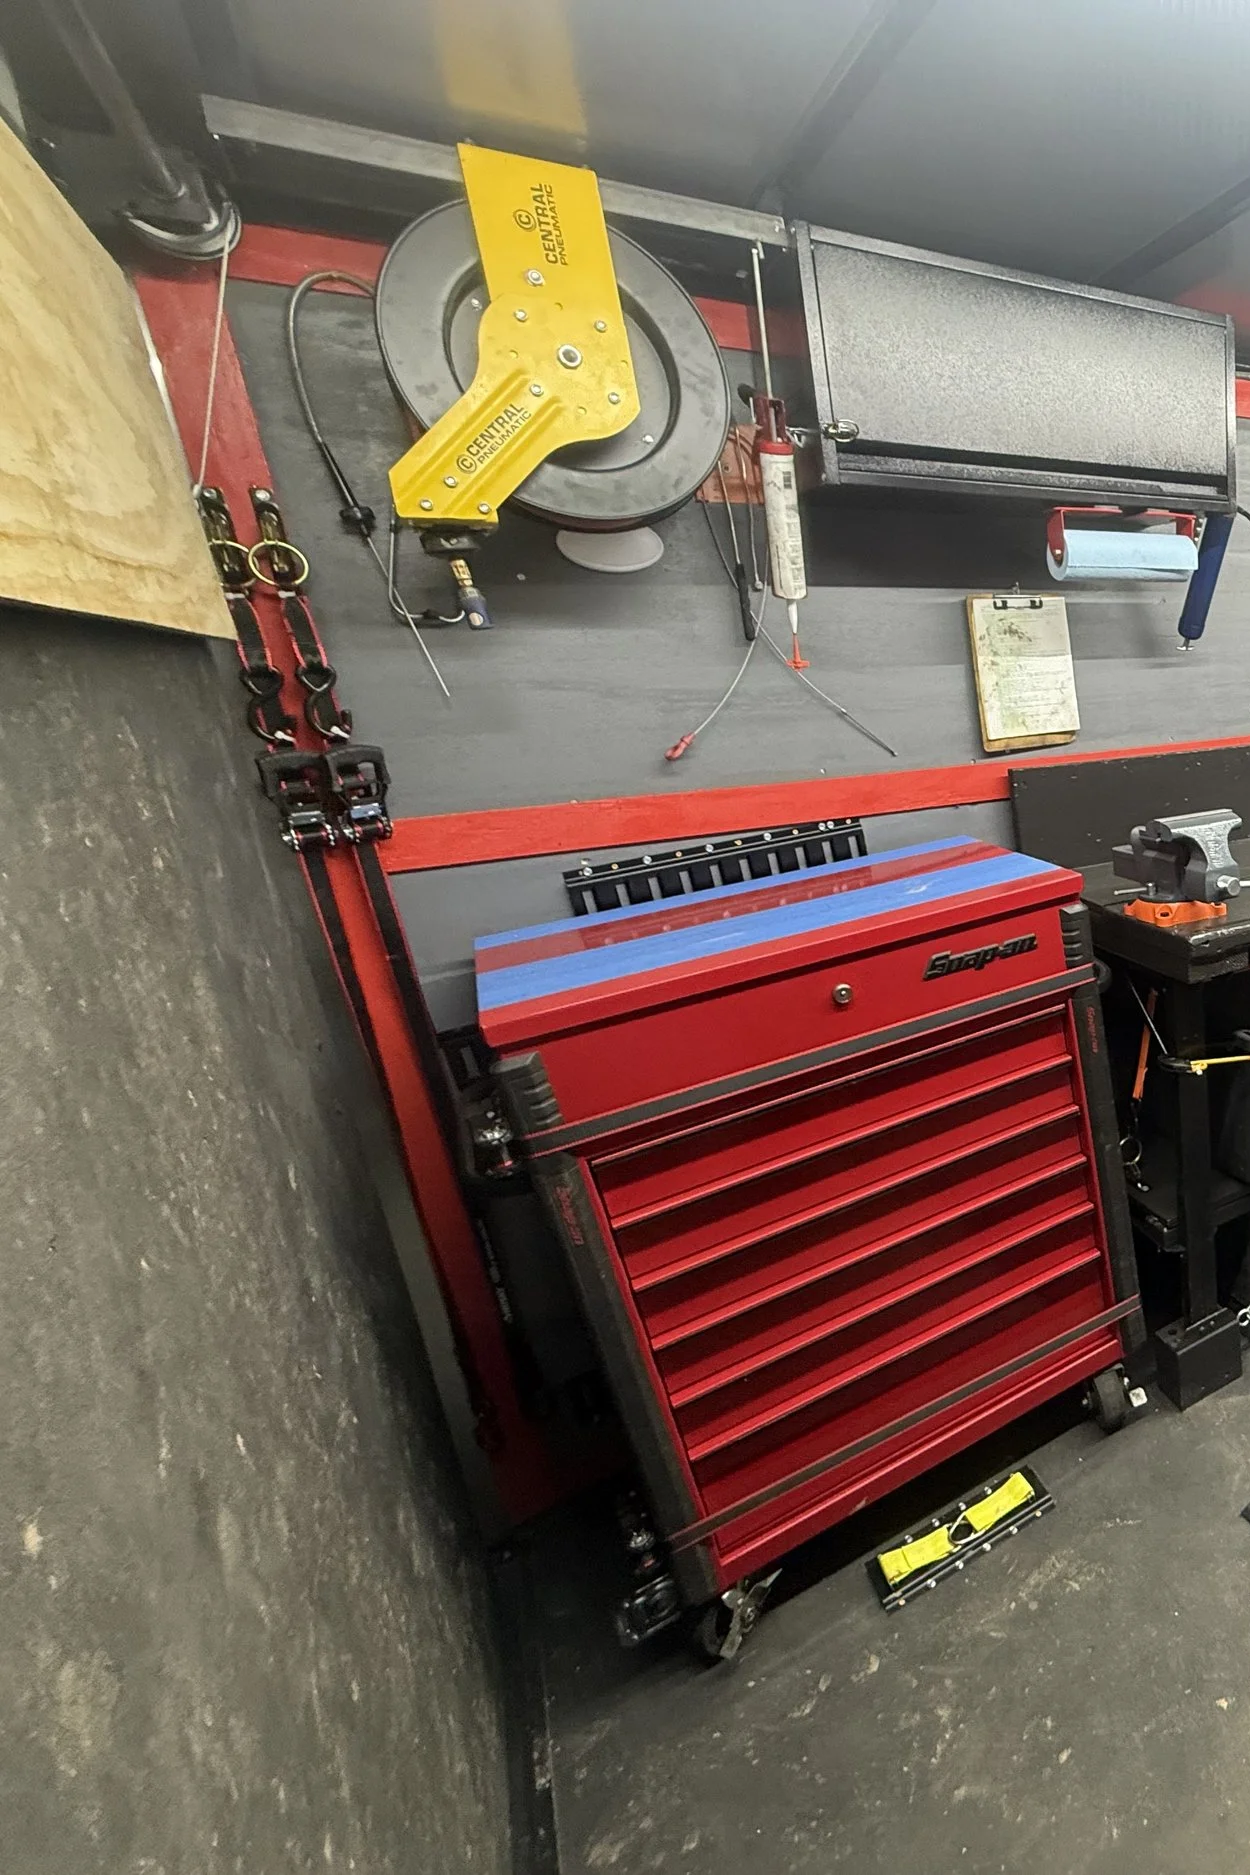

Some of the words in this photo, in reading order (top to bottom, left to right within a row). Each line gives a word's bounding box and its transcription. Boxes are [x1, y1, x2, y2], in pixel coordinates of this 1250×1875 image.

[530, 183, 559, 265] CENTRAL
[544, 184, 568, 266] PNEUMATIC
[466, 403, 524, 457] CENTRAL
[477, 410, 532, 464] PNEUMATIC
